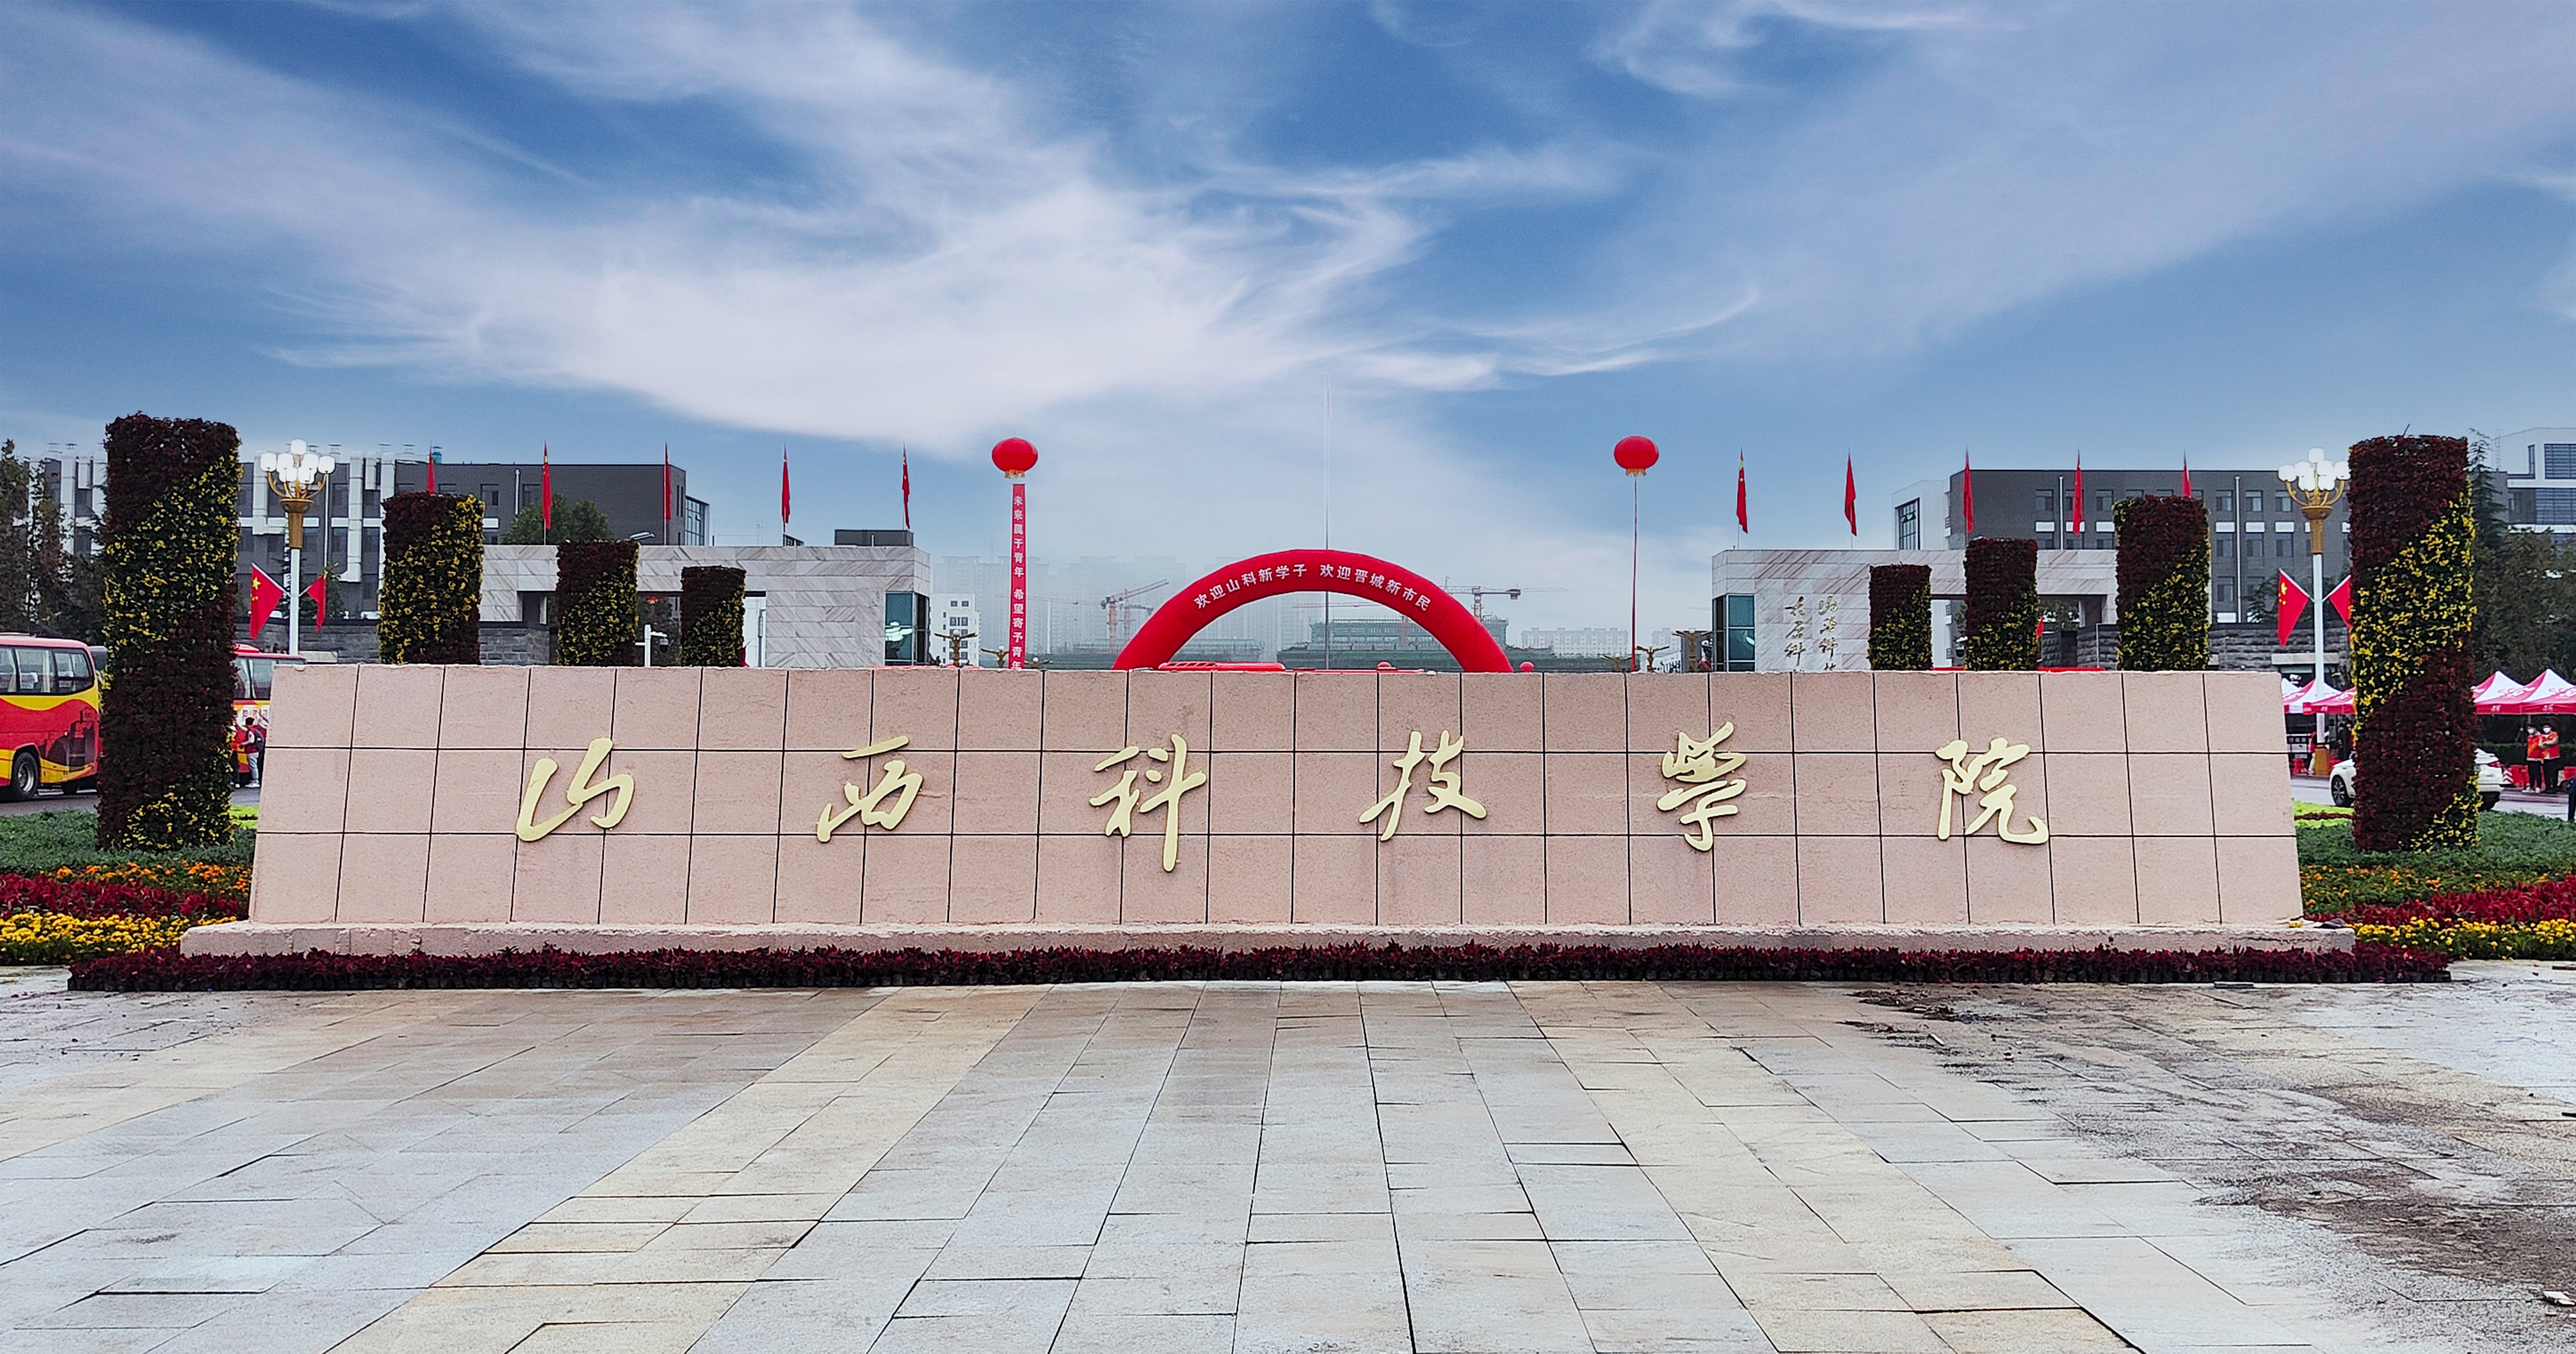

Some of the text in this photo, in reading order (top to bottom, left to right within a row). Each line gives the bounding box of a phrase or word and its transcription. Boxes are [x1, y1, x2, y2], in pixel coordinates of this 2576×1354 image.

[1011, 495, 1024, 669] 未来属于青年 希望寄予青年
[1194, 563, 1431, 611] 欢迎山科新学子 欢迎晋城新市民
